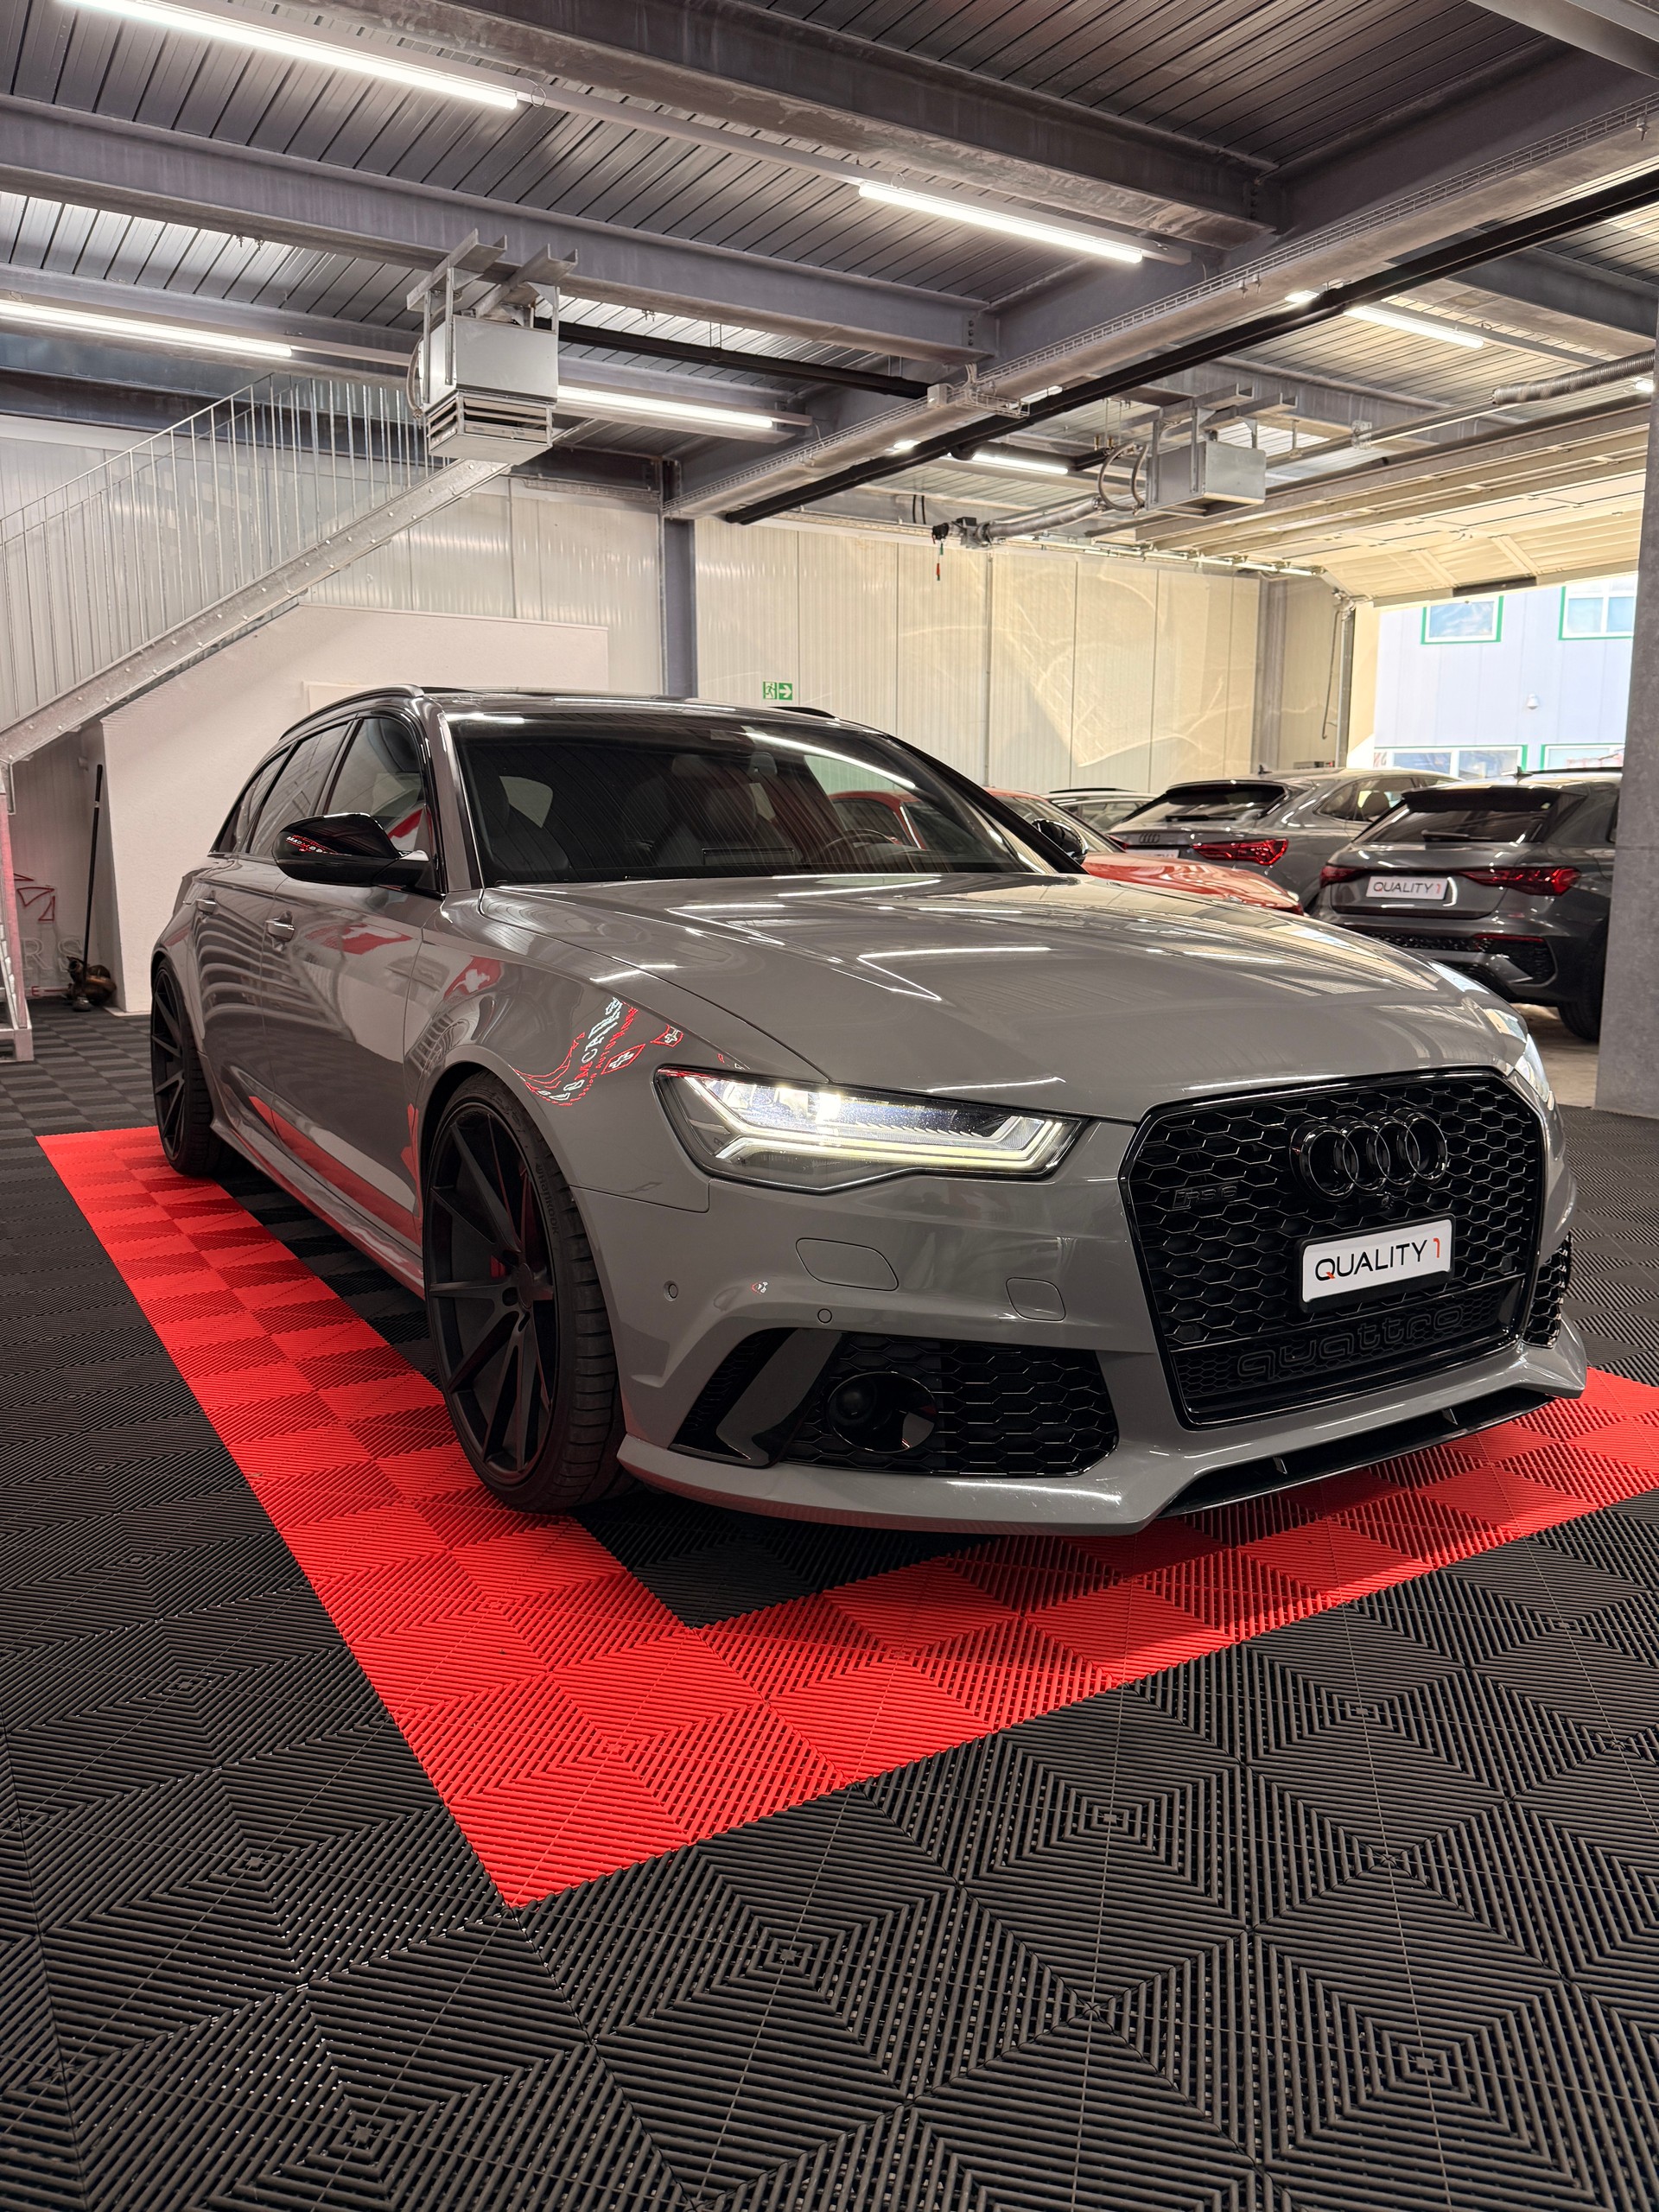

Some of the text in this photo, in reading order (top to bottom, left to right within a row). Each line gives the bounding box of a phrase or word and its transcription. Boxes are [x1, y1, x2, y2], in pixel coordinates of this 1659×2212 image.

[1373, 881, 1441, 894] QUALITY 1
[1315, 1237, 1440, 1281] QUALITY 1
[1237, 1305, 1464, 1380] quattro
